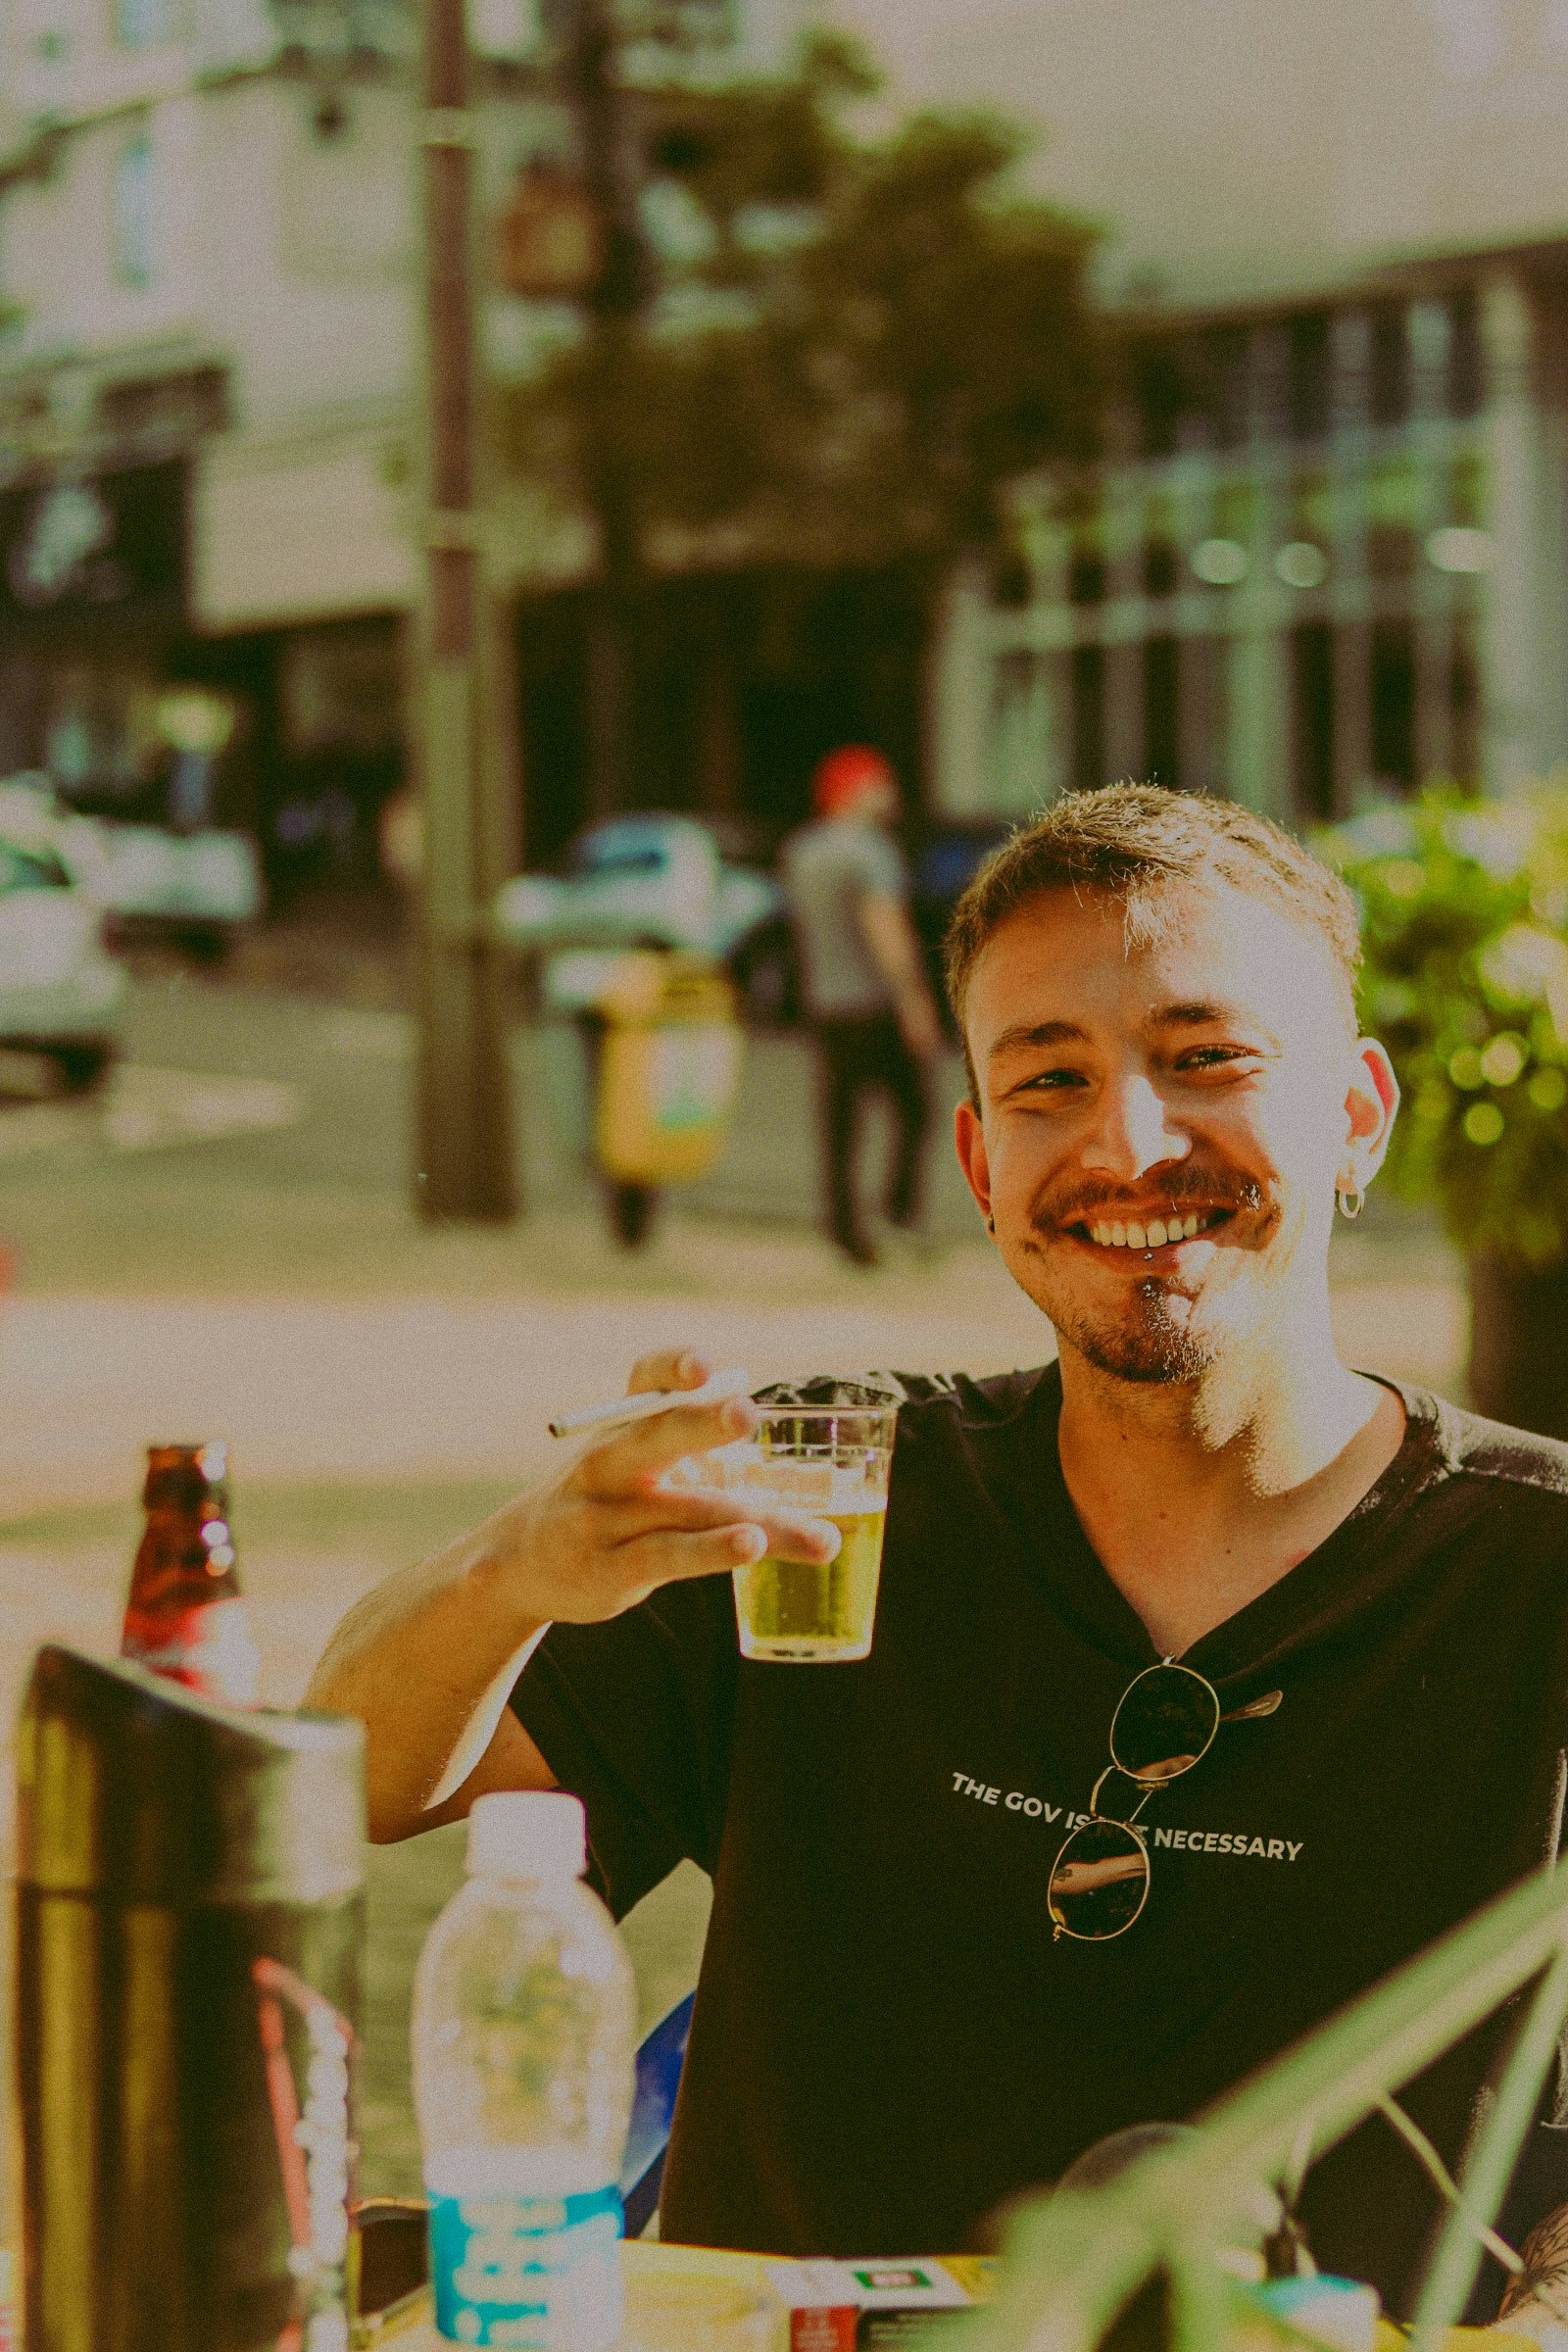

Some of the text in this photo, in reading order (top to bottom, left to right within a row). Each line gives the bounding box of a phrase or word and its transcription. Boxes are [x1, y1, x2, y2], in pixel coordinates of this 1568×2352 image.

[952, 1772, 1002, 1806] THE
[1004, 1791, 1062, 1823] GOV
[1065, 1811, 1091, 1830] IS
[1153, 1828, 1303, 1862] NECESSARY
